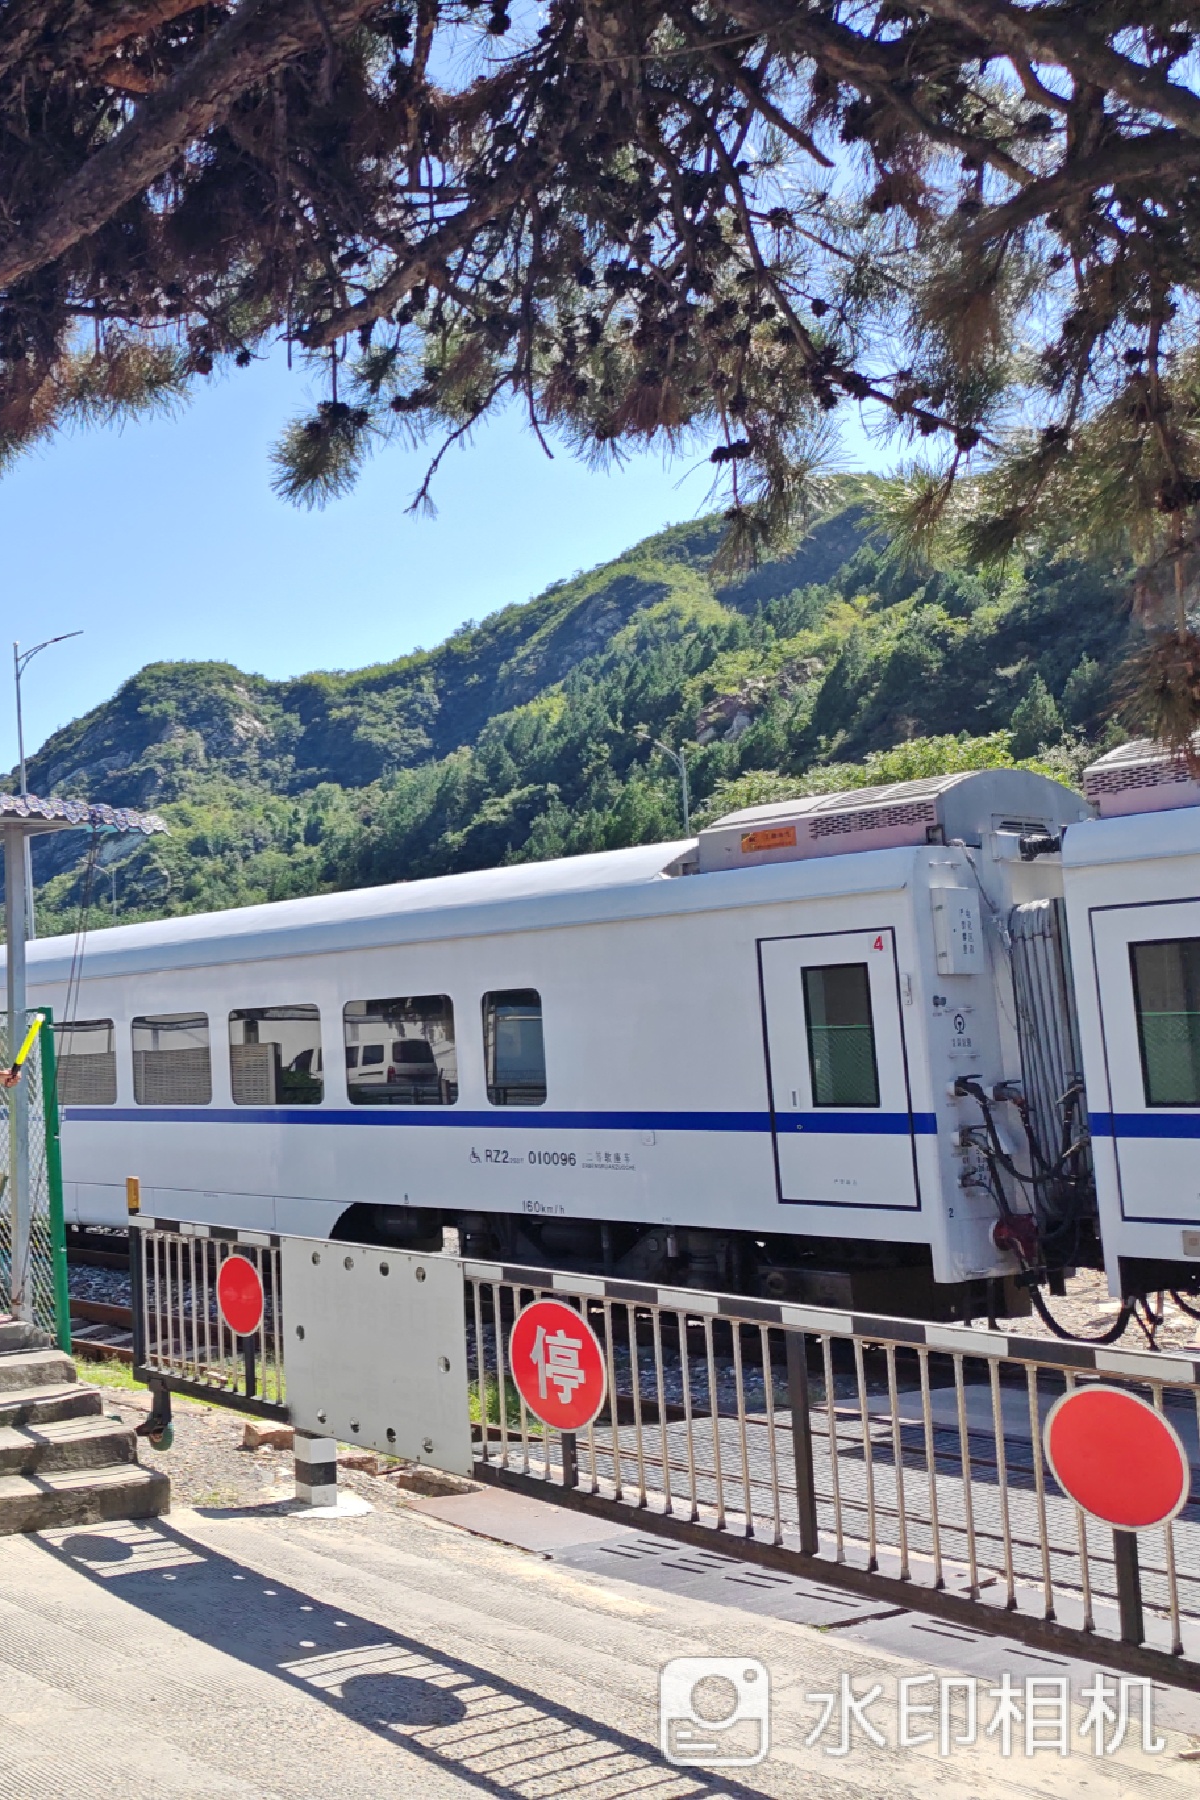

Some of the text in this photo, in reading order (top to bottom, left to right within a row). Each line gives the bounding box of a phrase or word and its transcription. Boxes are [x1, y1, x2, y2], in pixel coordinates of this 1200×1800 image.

[873, 935, 884, 951] 4
[528, 1150, 577, 1167] 010096
[522, 1200, 565, 1214] 160km/h
[530, 1324, 585, 1405] 停
